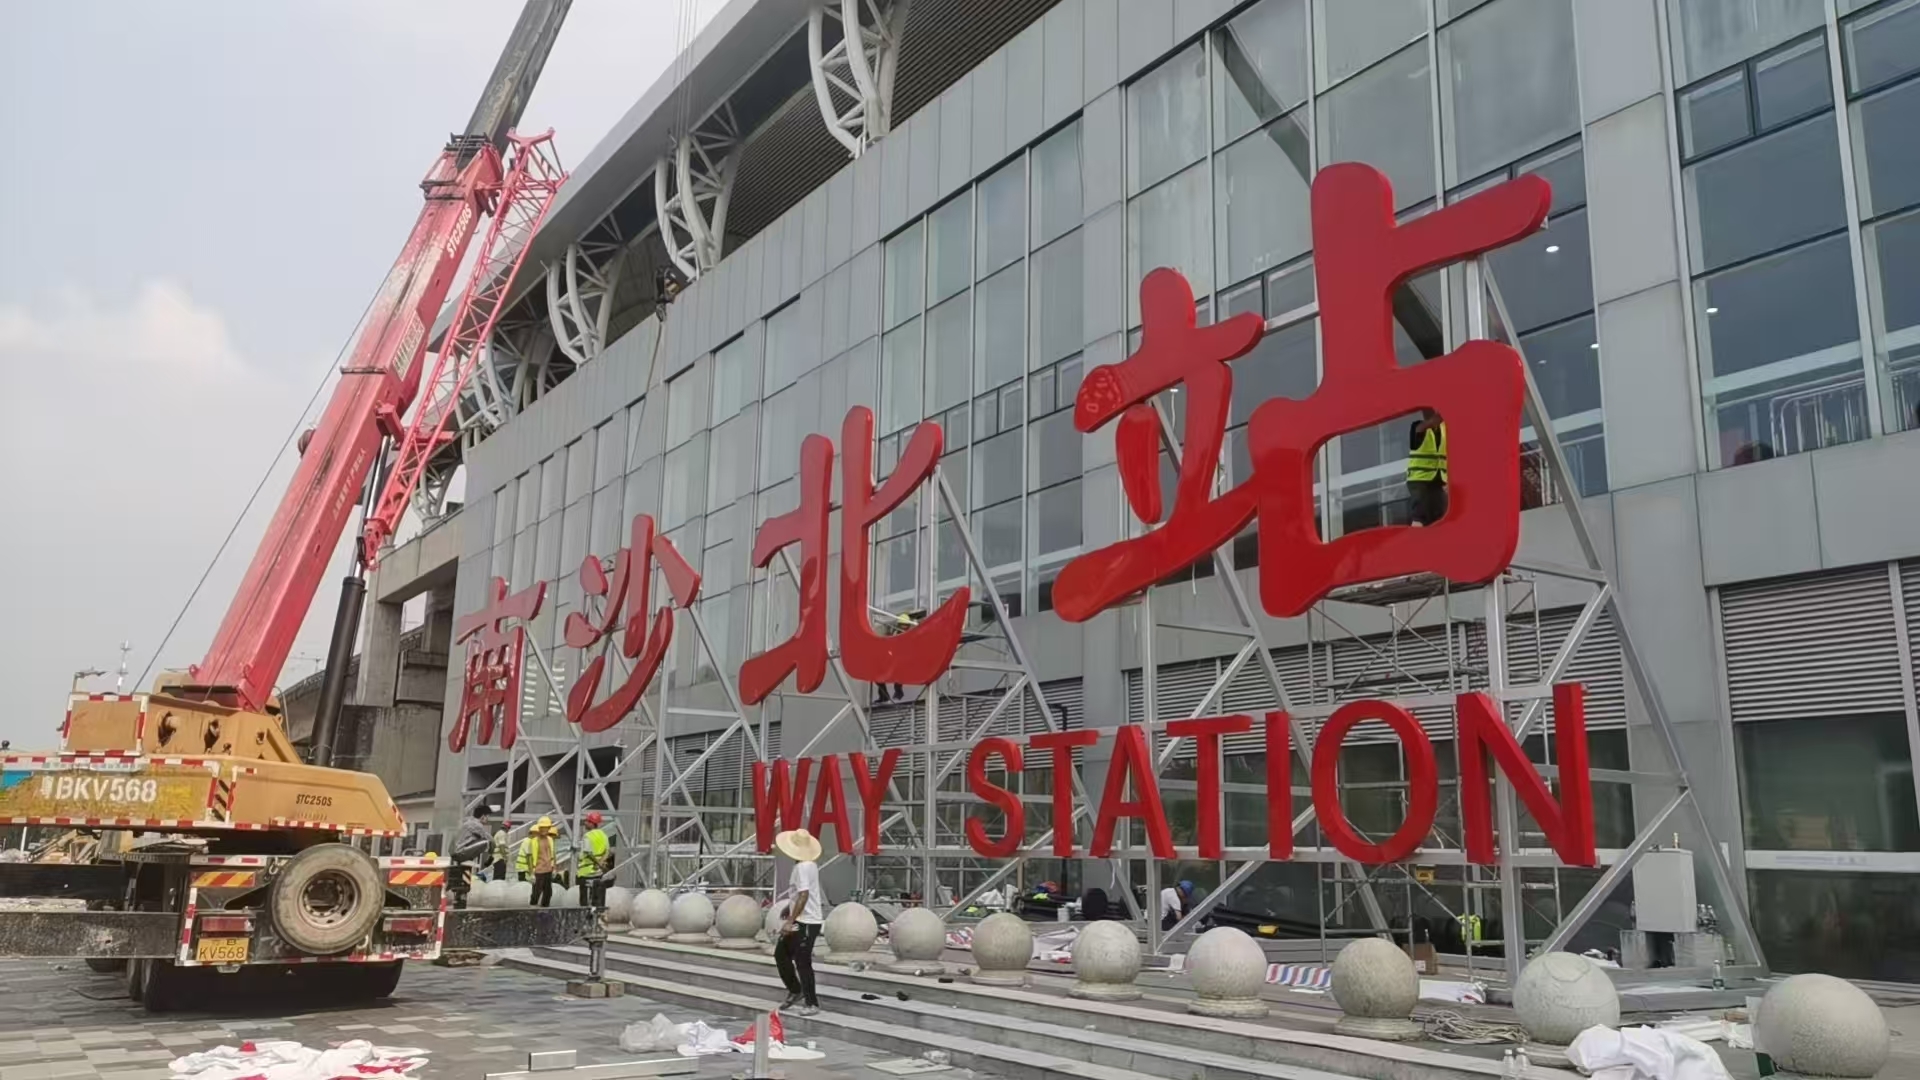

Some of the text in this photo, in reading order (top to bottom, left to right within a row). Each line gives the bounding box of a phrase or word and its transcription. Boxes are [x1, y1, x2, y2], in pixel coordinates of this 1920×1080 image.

[447, 203, 472, 259] STC250S
[449, 163, 1552, 753] 南沙北站
[296, 793, 332, 807] STC250S
[752, 683, 1597, 868] WAY STATION
[199, 946, 245, 960] KV568
